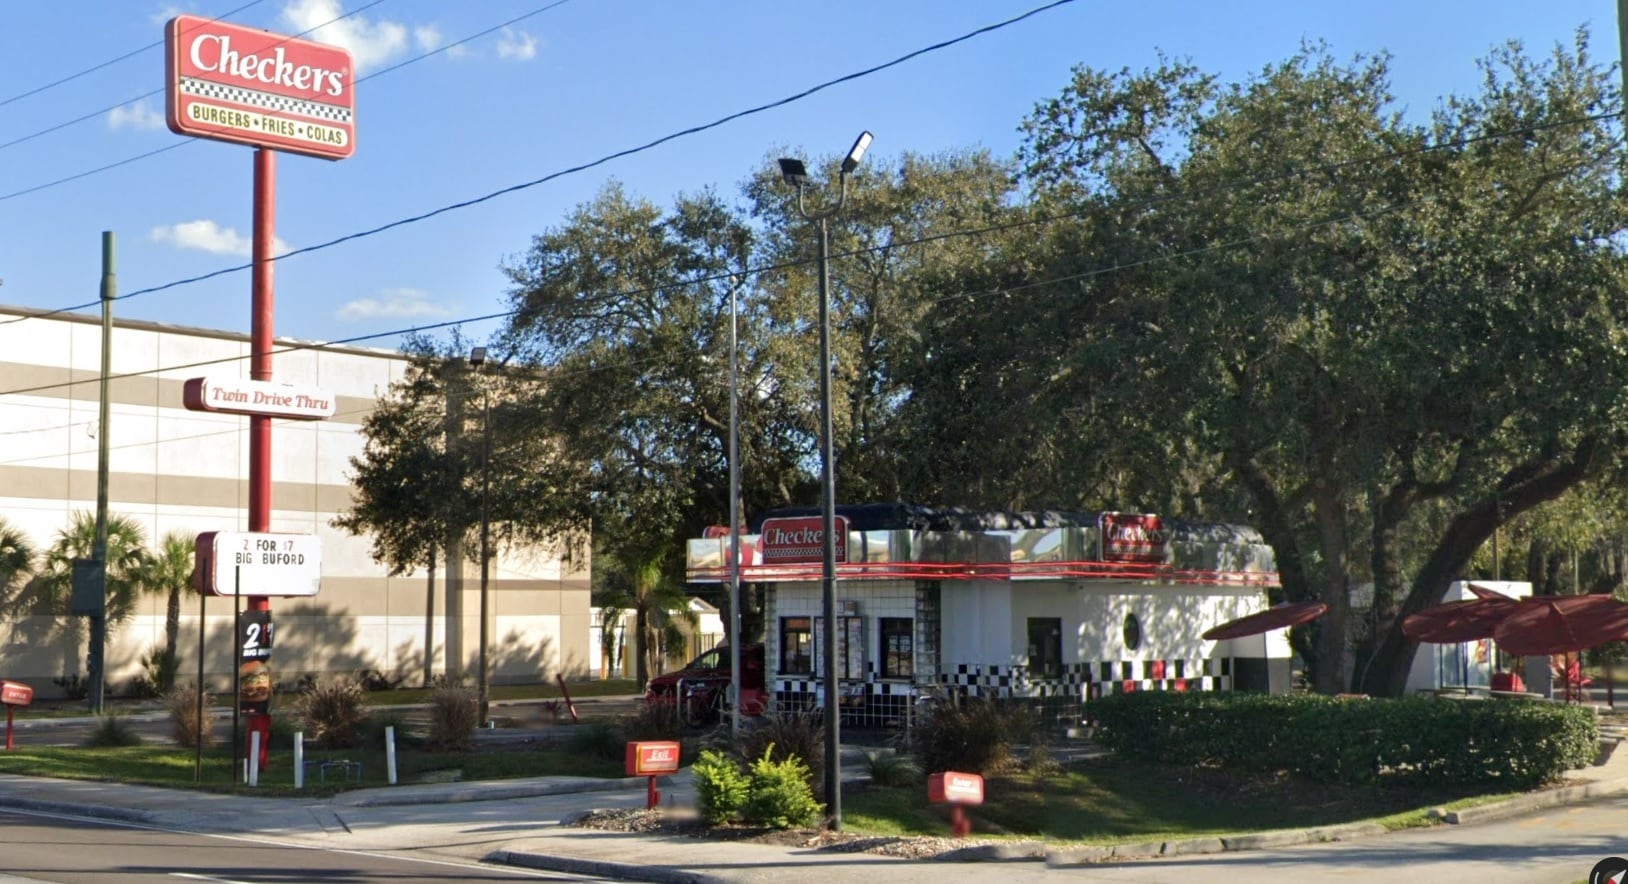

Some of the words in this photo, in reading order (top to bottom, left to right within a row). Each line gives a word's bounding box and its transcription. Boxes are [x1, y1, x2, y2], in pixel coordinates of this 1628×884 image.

[190, 34, 343, 96] Checkers
[193, 105, 251, 128] BURGERS
[262, 117, 295, 136] FRIES
[306, 125, 342, 145] COLAS
[213, 387, 249, 403] Twin
[253, 391, 292, 406] Drive
[296, 395, 329, 410] Thru
[243, 539, 249, 550] 2
[256, 539, 277, 551] FOR
[764, 527, 840, 545] Checkes
[235, 552, 252, 564] BIG
[262, 553, 305, 565] BUFORD
[243, 623, 261, 649] 2
[651, 749, 669, 759] Exit
